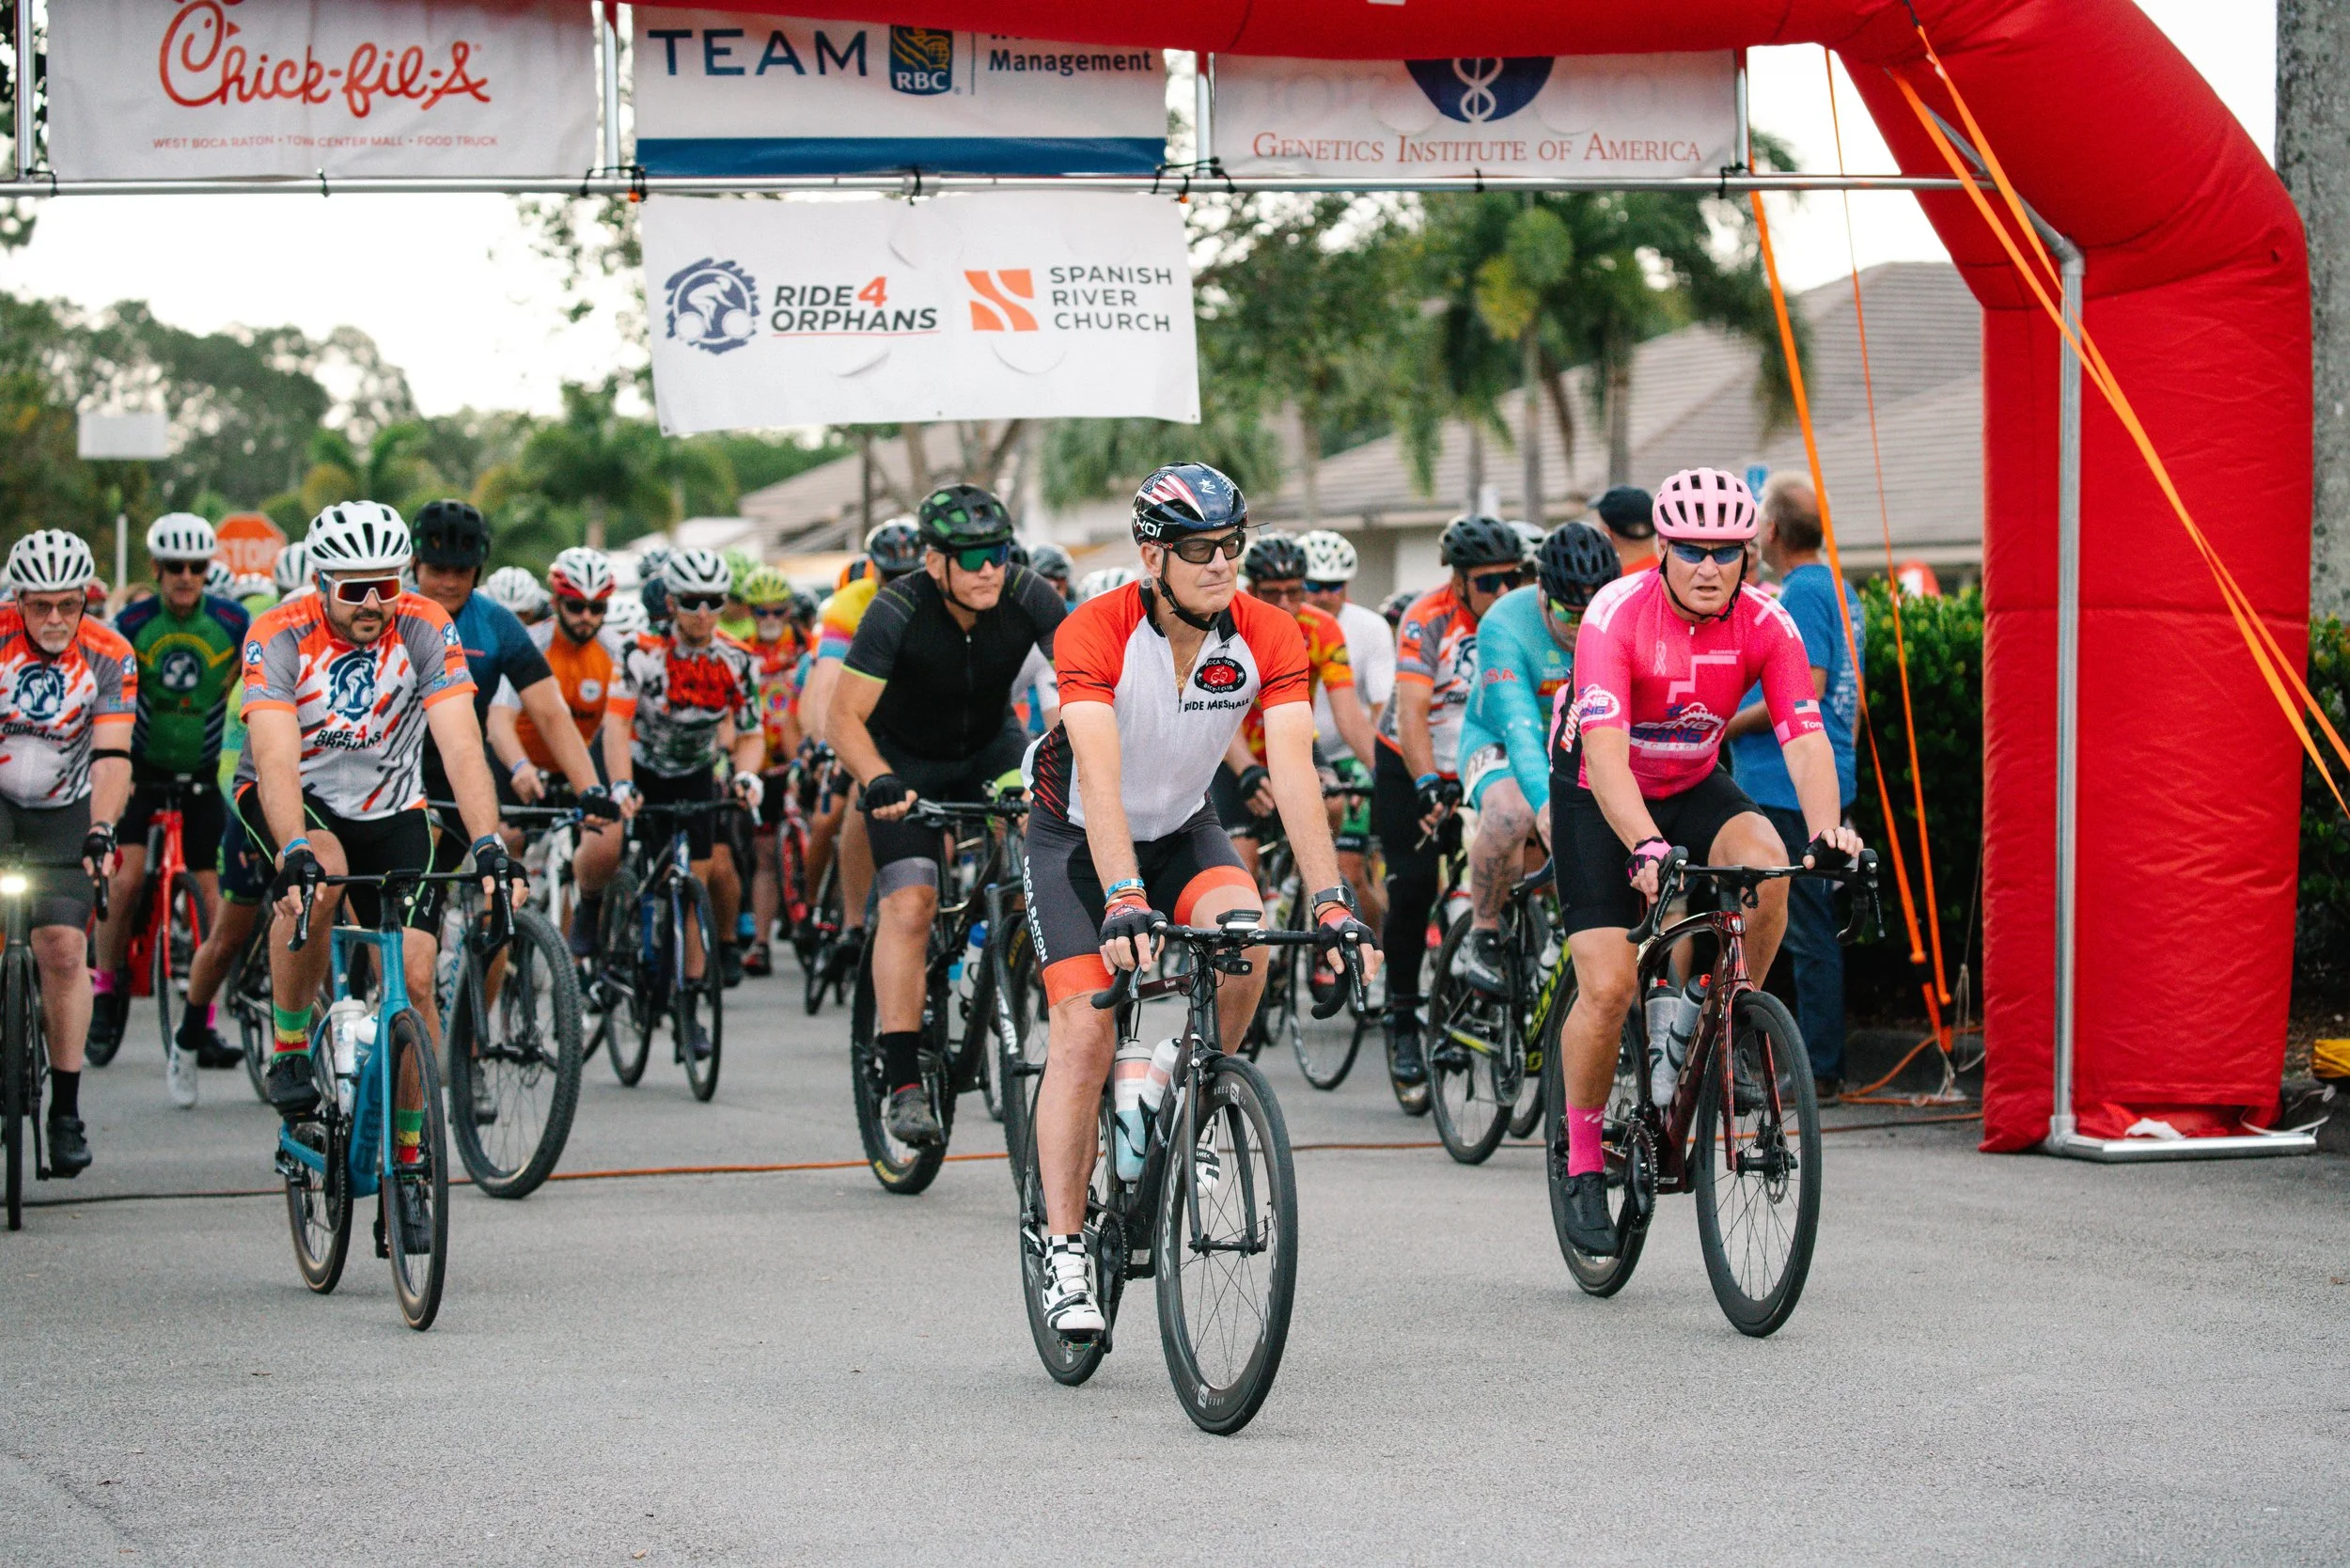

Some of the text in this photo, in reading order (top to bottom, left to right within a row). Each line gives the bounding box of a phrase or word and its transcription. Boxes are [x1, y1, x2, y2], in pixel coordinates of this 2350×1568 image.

[159, 0, 491, 118] Chick-fil-A
[648, 29, 867, 76] TEAM
[989, 49, 1152, 76] Management
[896, 71, 948, 90] RBC
[153, 135, 498, 149] WEST BOCA RATON TOWN CENTER MALL FOOD TRUCK
[1050, 266, 1172, 285] SPANISH
[775, 275, 888, 307] RIDE 4
[1053, 289, 1137, 307] RIVER
[771, 307, 938, 332] ORPHANS
[1055, 312, 1171, 332] CHURCH
[216, 538, 279, 572] STOP
[1184, 698, 1249, 712] RIDE MARSHALL
[313, 731, 382, 750] ORPHANS
[317, 725, 368, 741] RIDE 4
[1024, 855, 1048, 963] BOCA RATON
